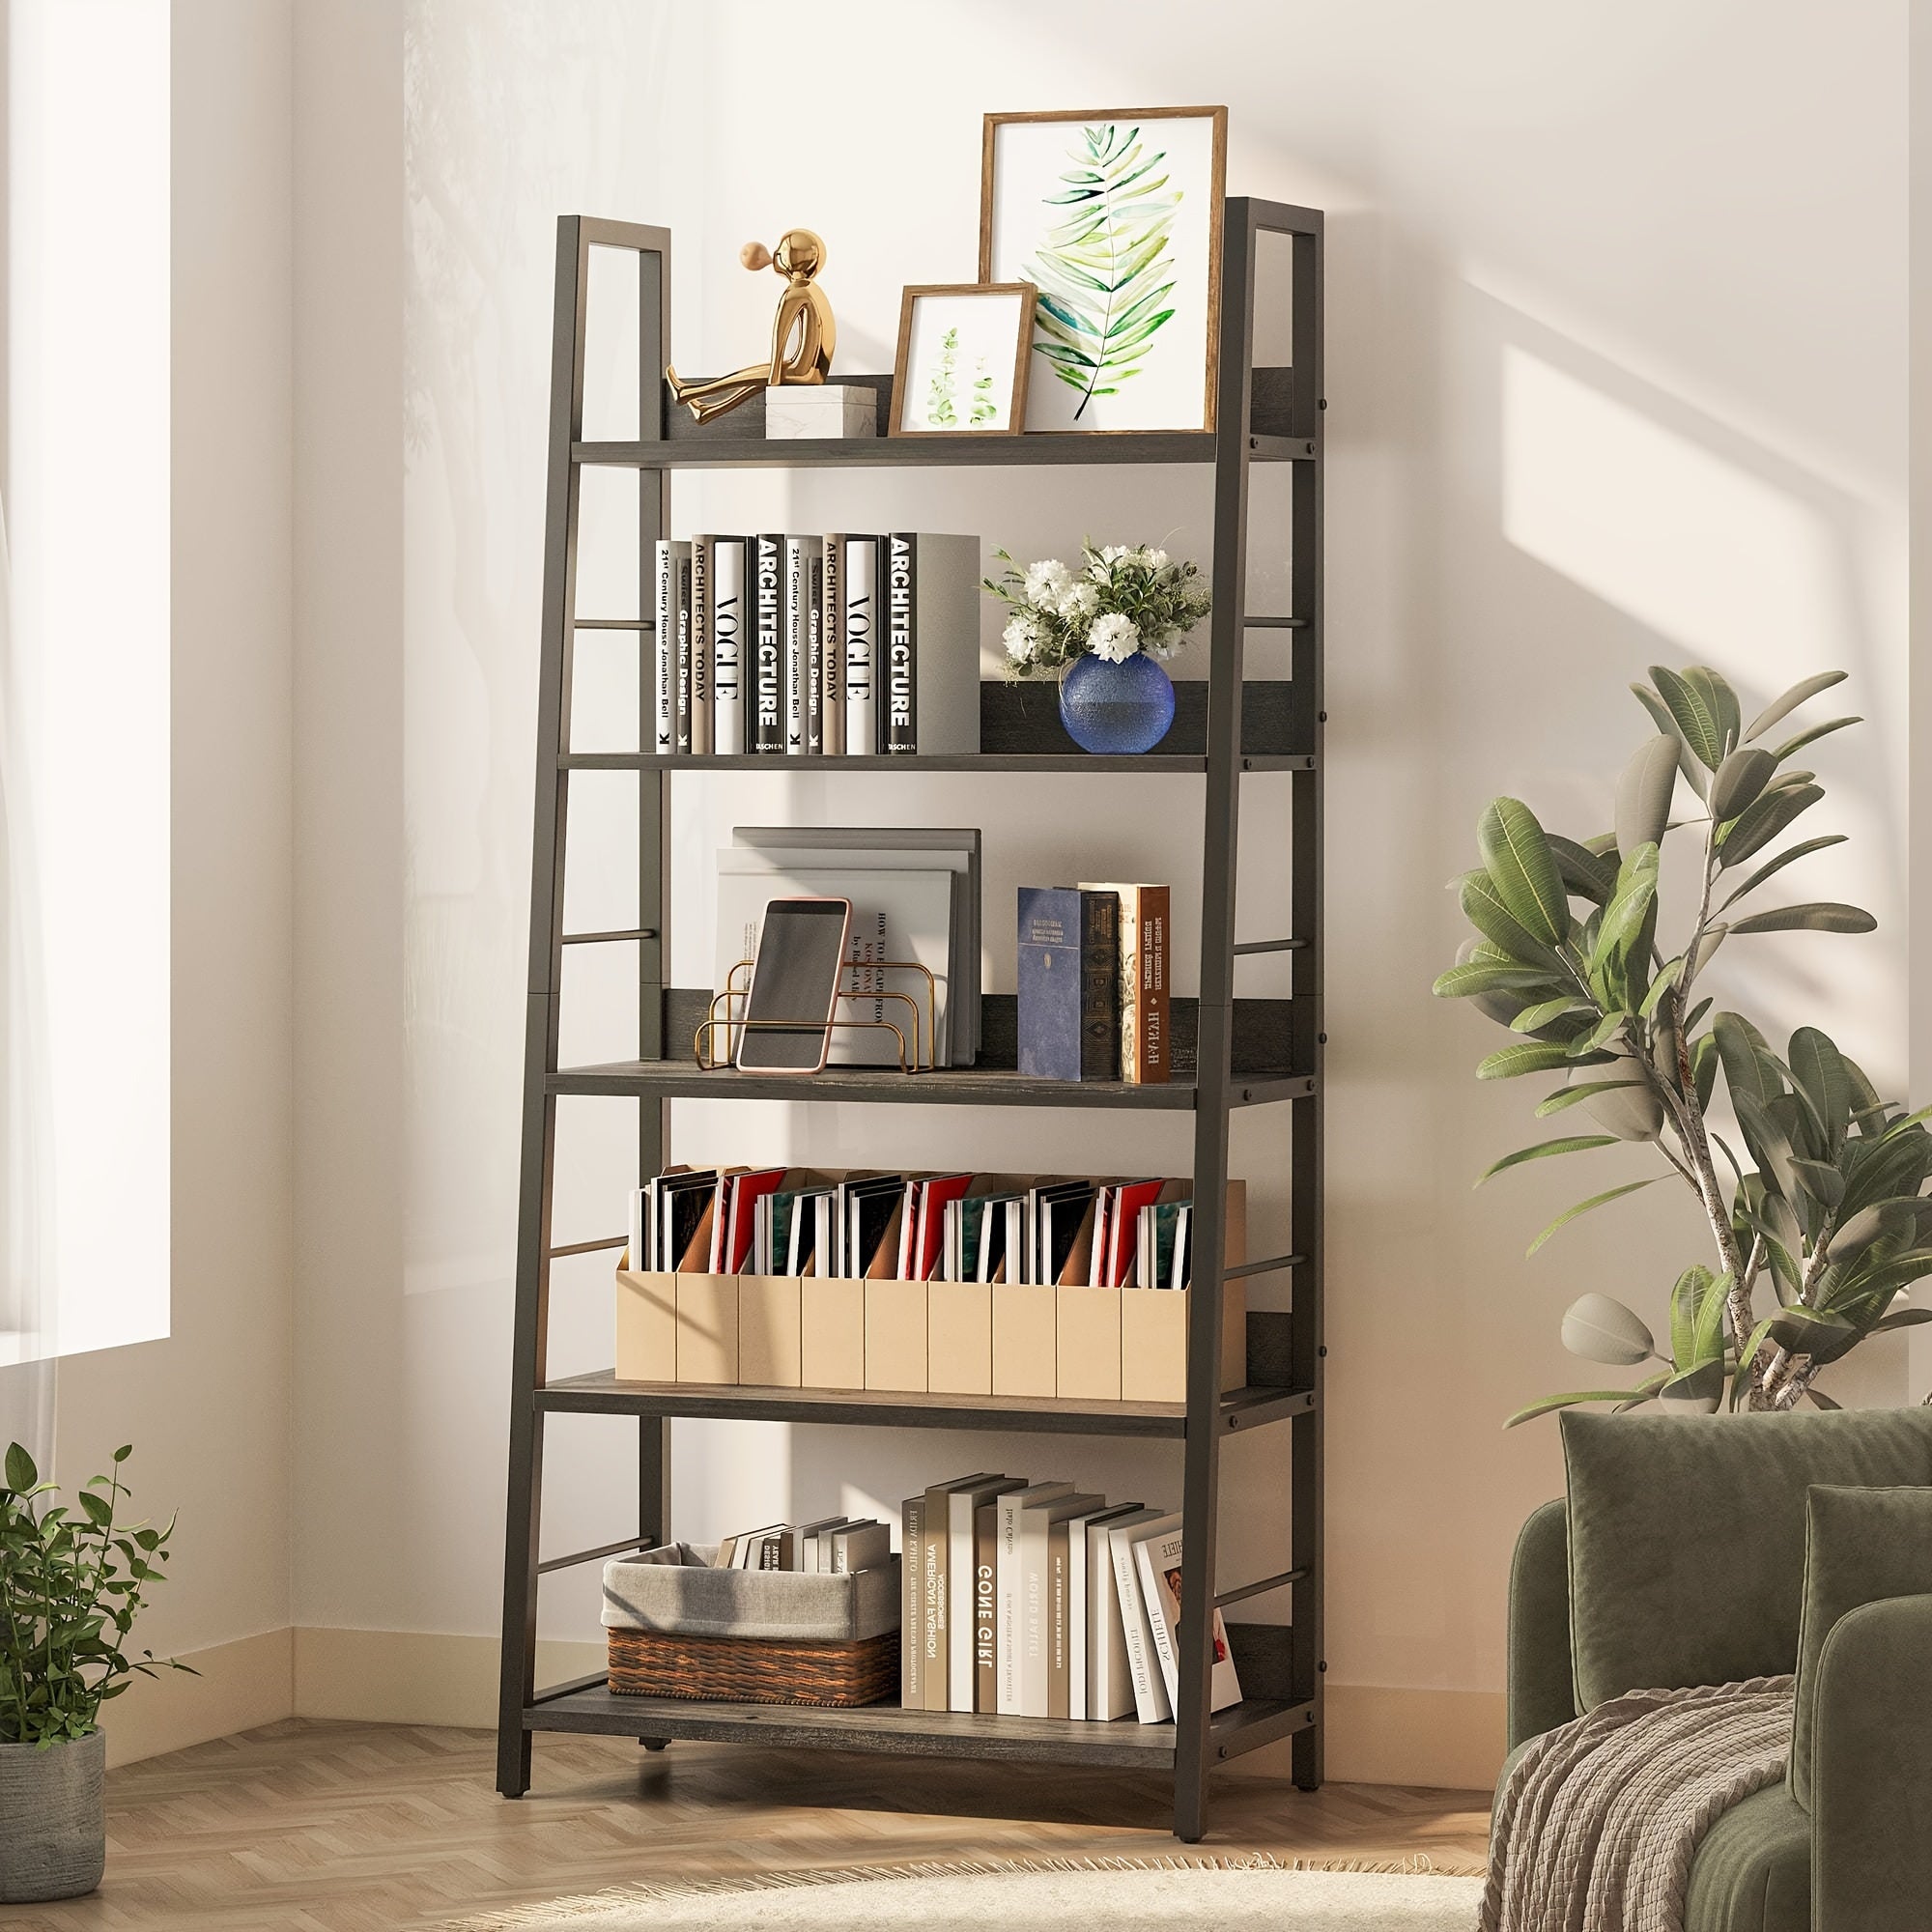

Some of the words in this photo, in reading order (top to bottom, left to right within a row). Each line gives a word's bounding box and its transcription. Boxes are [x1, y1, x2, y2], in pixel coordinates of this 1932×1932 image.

[696, 544, 705, 644] ARCHITECTS
[791, 572, 800, 611] Century
[827, 542, 837, 644] ARCHITECTS
[678, 610, 688, 665] Graphic
[716, 594, 739, 700] VOGUE
[758, 538, 778, 726] ARCHITECTURE
[809, 609, 819, 665] Graphic
[848, 594, 870, 700] VOGUE
[891, 537, 910, 726] ARCHITECTURE
[678, 668, 688, 716] Design
[696, 649, 705, 702] TODAY
[809, 668, 819, 716] Design
[827, 649, 837, 702] TODAY
[659, 733, 670, 745] K
[678, 734, 688, 747] K
[790, 733, 801, 745] K
[809, 734, 818, 747] K
[877, 941, 885, 954] TO
